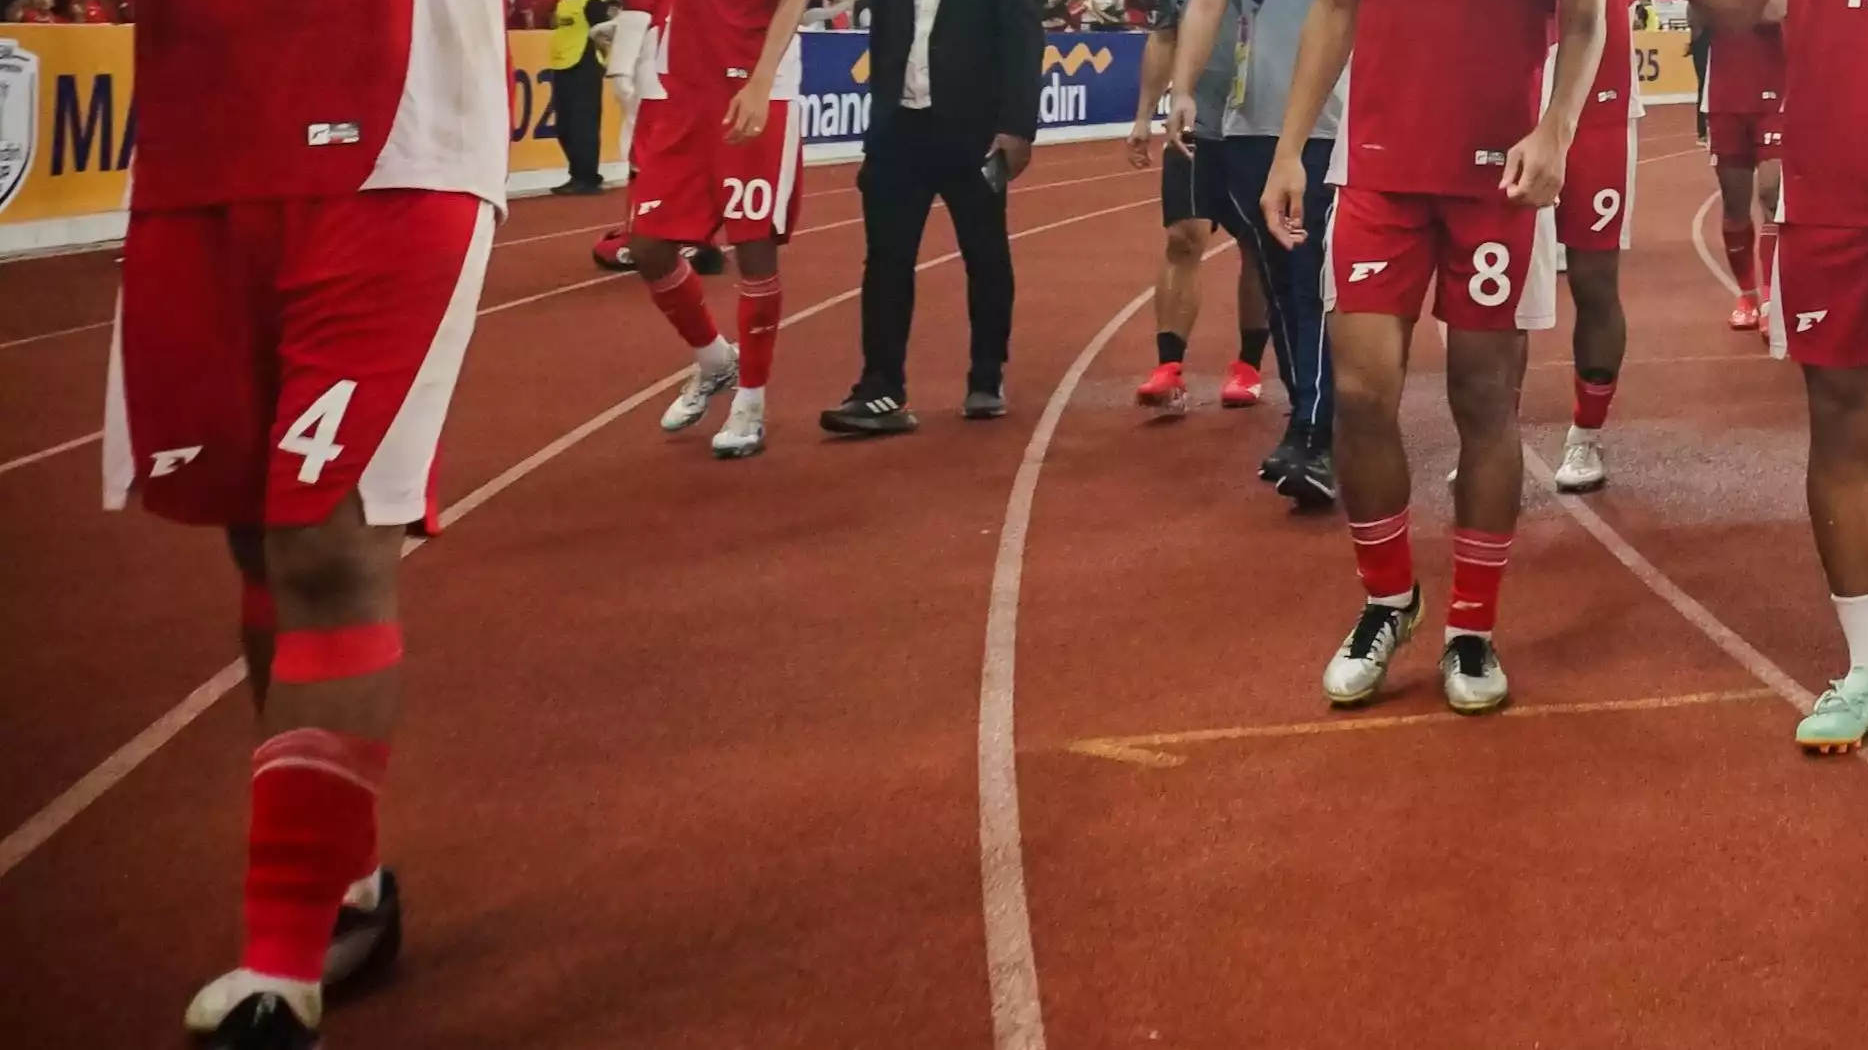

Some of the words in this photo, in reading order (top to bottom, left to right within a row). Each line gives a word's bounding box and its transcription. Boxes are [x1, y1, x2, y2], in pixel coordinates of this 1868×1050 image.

[723, 177, 772, 221] 20
[1590, 188, 1621, 232] 9
[1468, 241, 1511, 307] 8
[278, 379, 358, 484] 4
